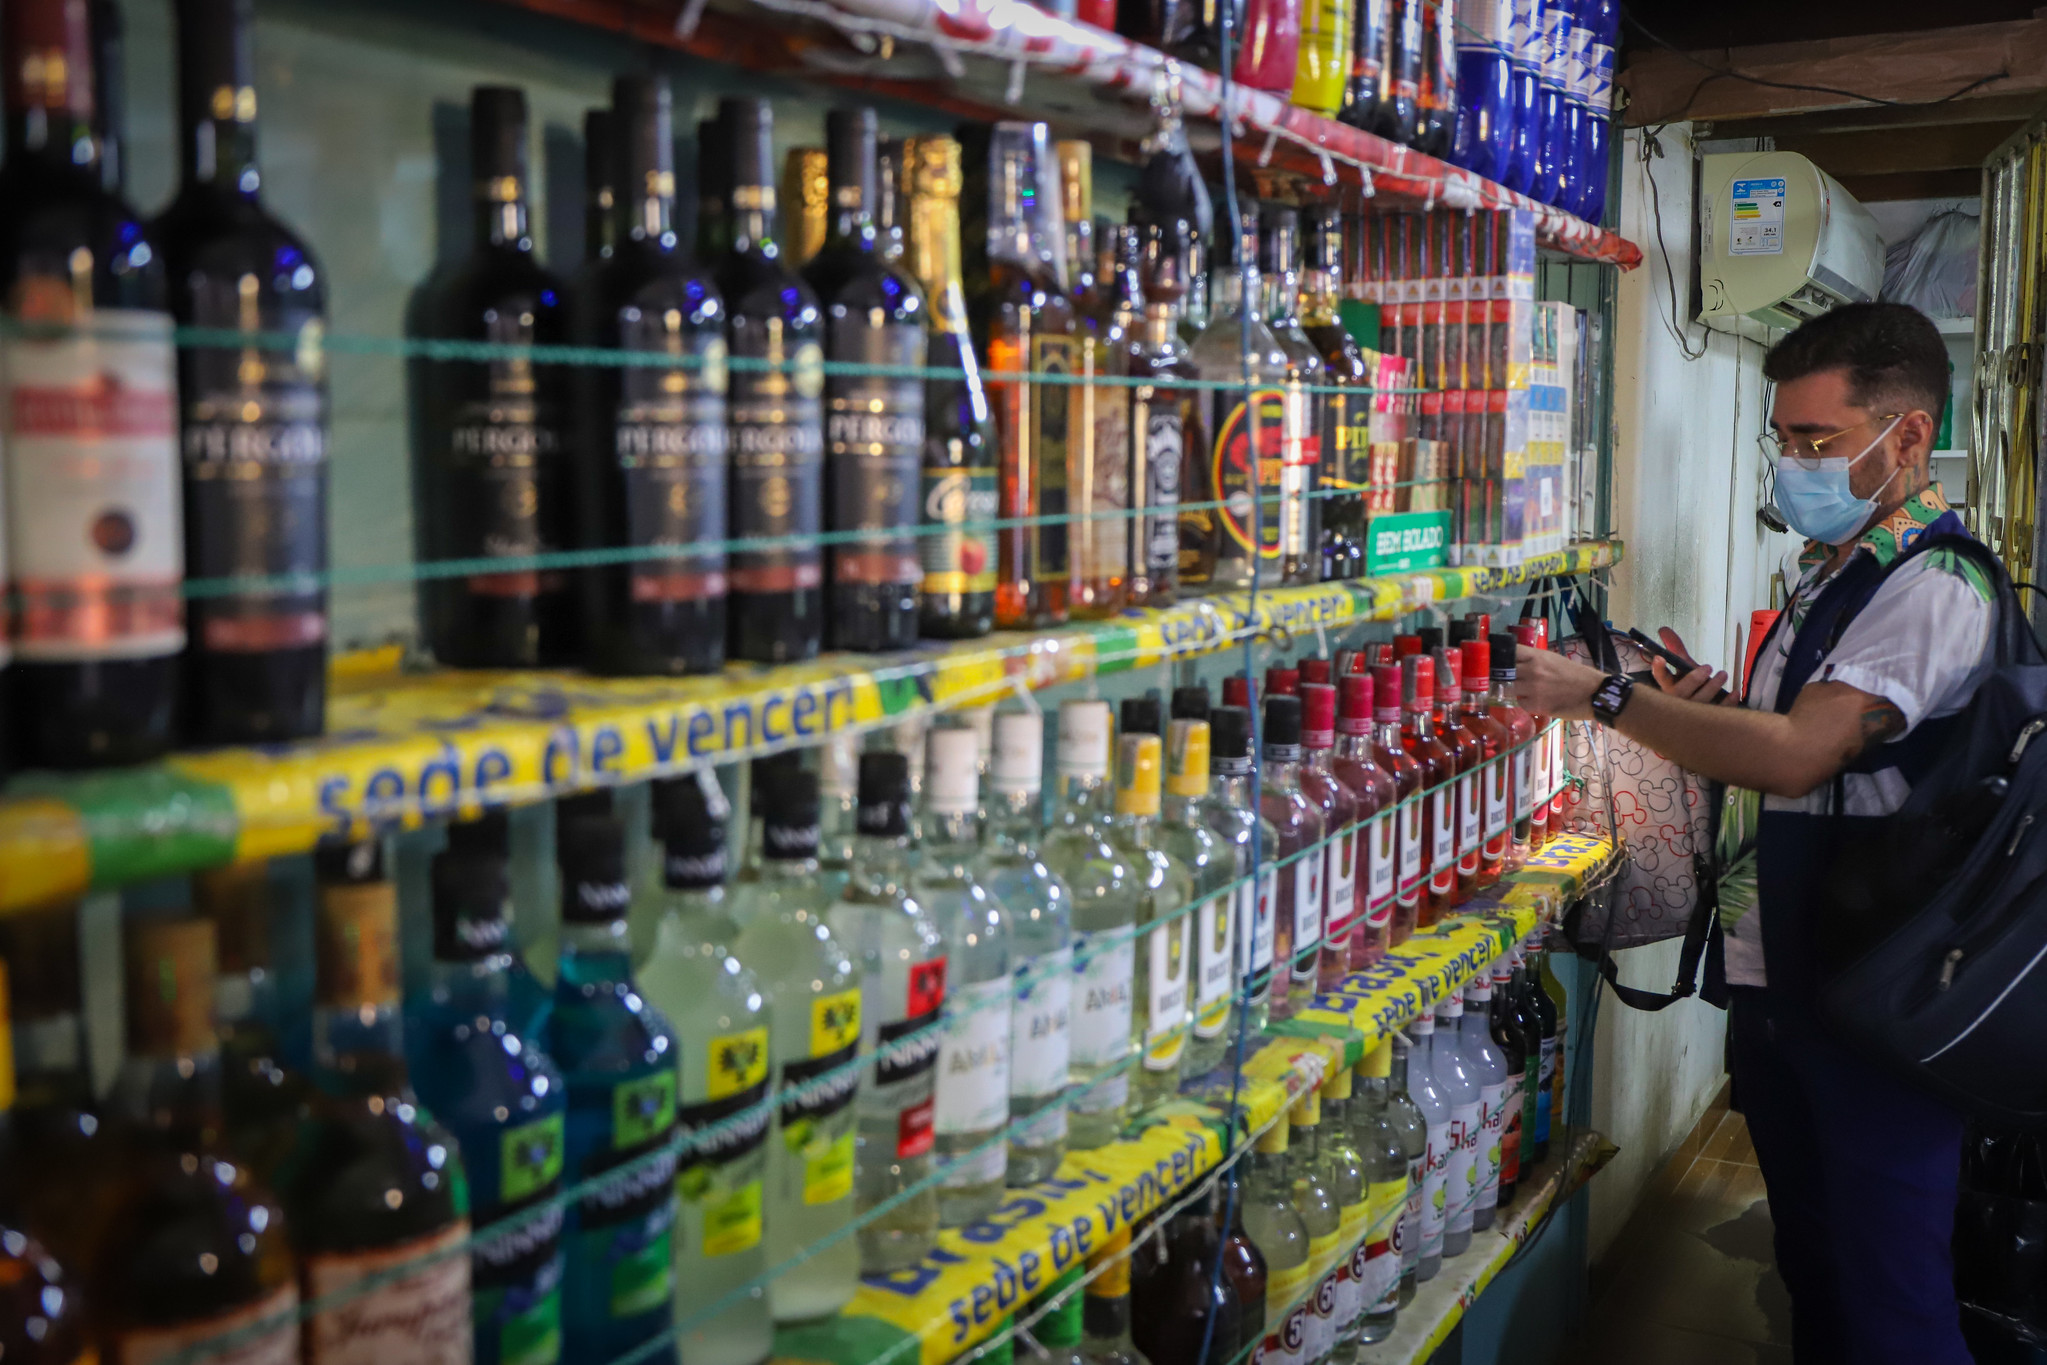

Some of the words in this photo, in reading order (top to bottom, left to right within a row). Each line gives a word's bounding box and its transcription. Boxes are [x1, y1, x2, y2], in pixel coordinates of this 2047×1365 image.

[1375, 530, 1402, 556] BEM
[1402, 525, 1444, 553] BOLADO
[318, 742, 511, 822] sede
[543, 723, 625, 787] de
[645, 675, 858, 766] vencer!
[1438, 932, 1497, 988] vencer!
[949, 1250, 1041, 1344] sede
[1046, 1215, 1093, 1271] de
[1095, 1131, 1208, 1234] vencer!
